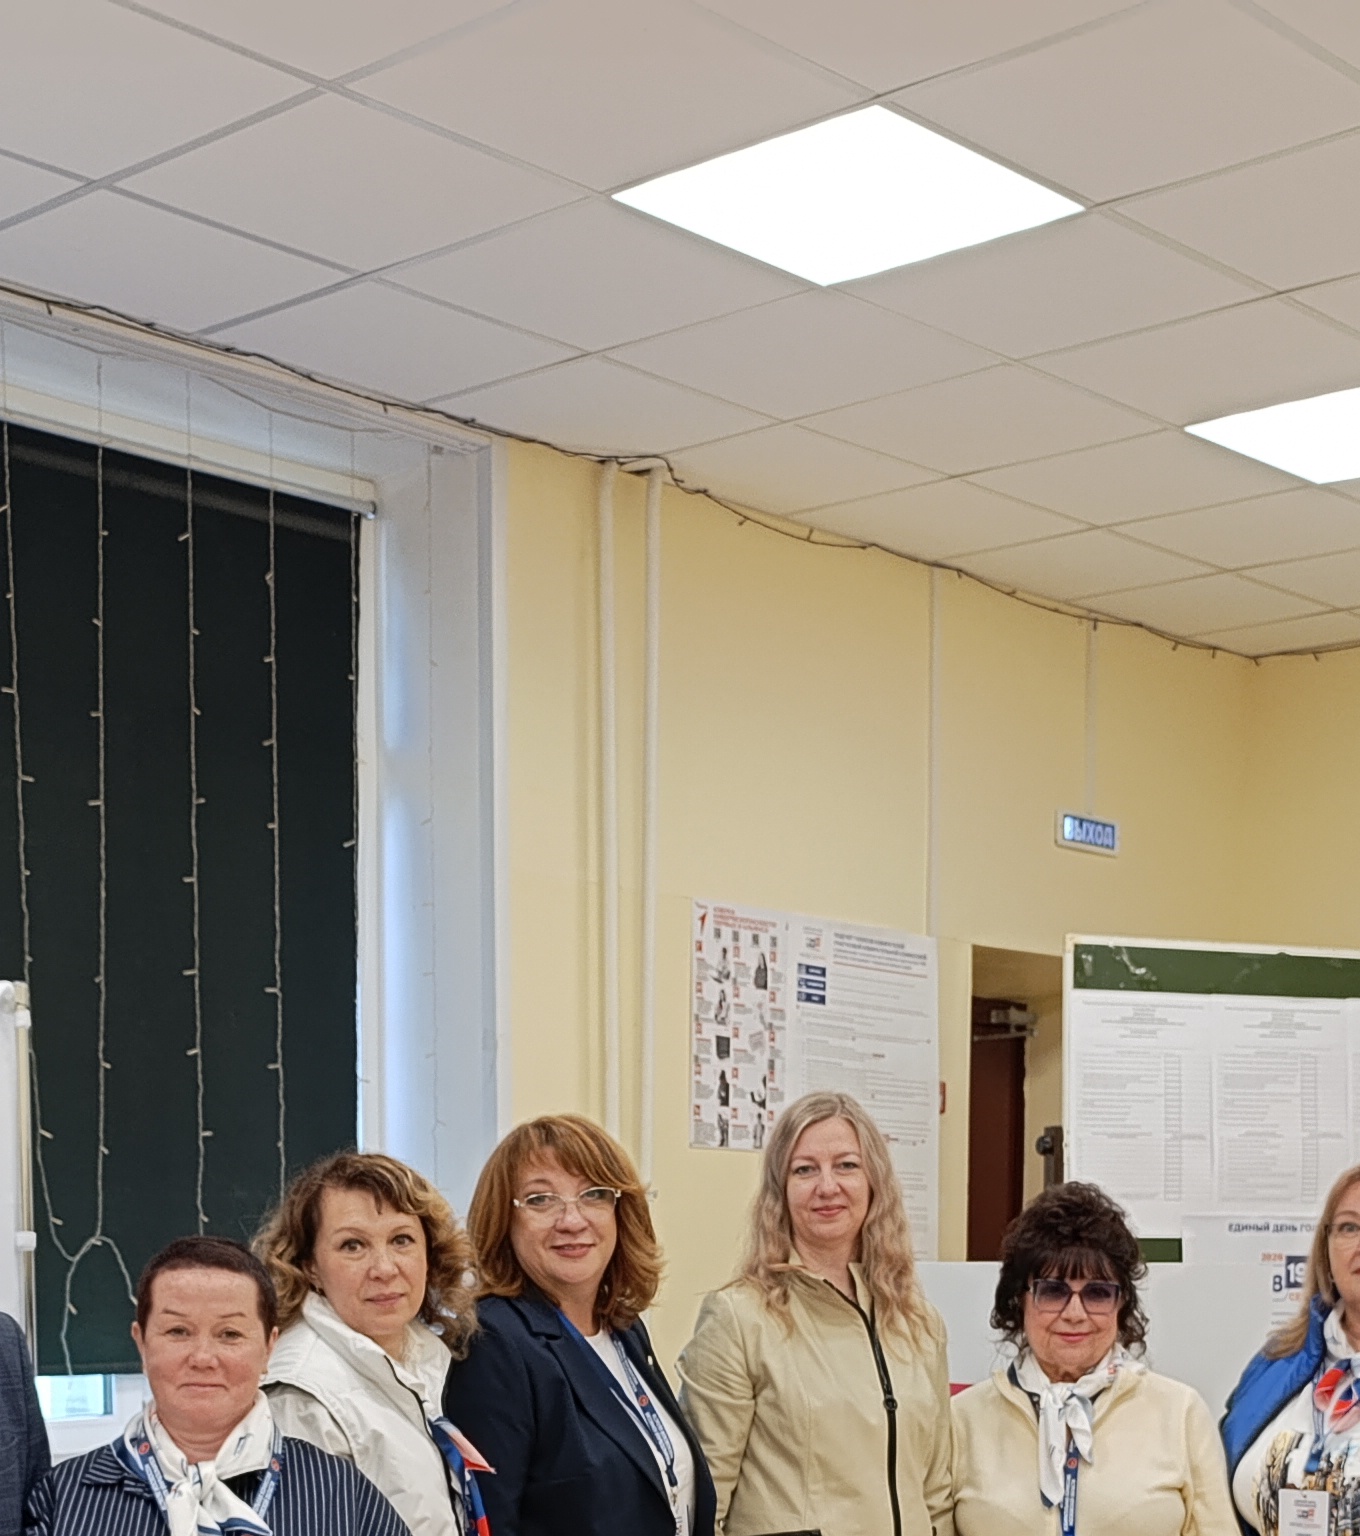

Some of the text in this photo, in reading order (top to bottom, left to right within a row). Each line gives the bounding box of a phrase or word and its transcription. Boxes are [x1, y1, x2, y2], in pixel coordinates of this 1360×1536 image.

[1064, 816, 1114, 848] ВЫХОД
[1228, 1222, 1270, 1233] ЕДИНЫЙ
[1272, 1223, 1298, 1233] ДЕНЬ
